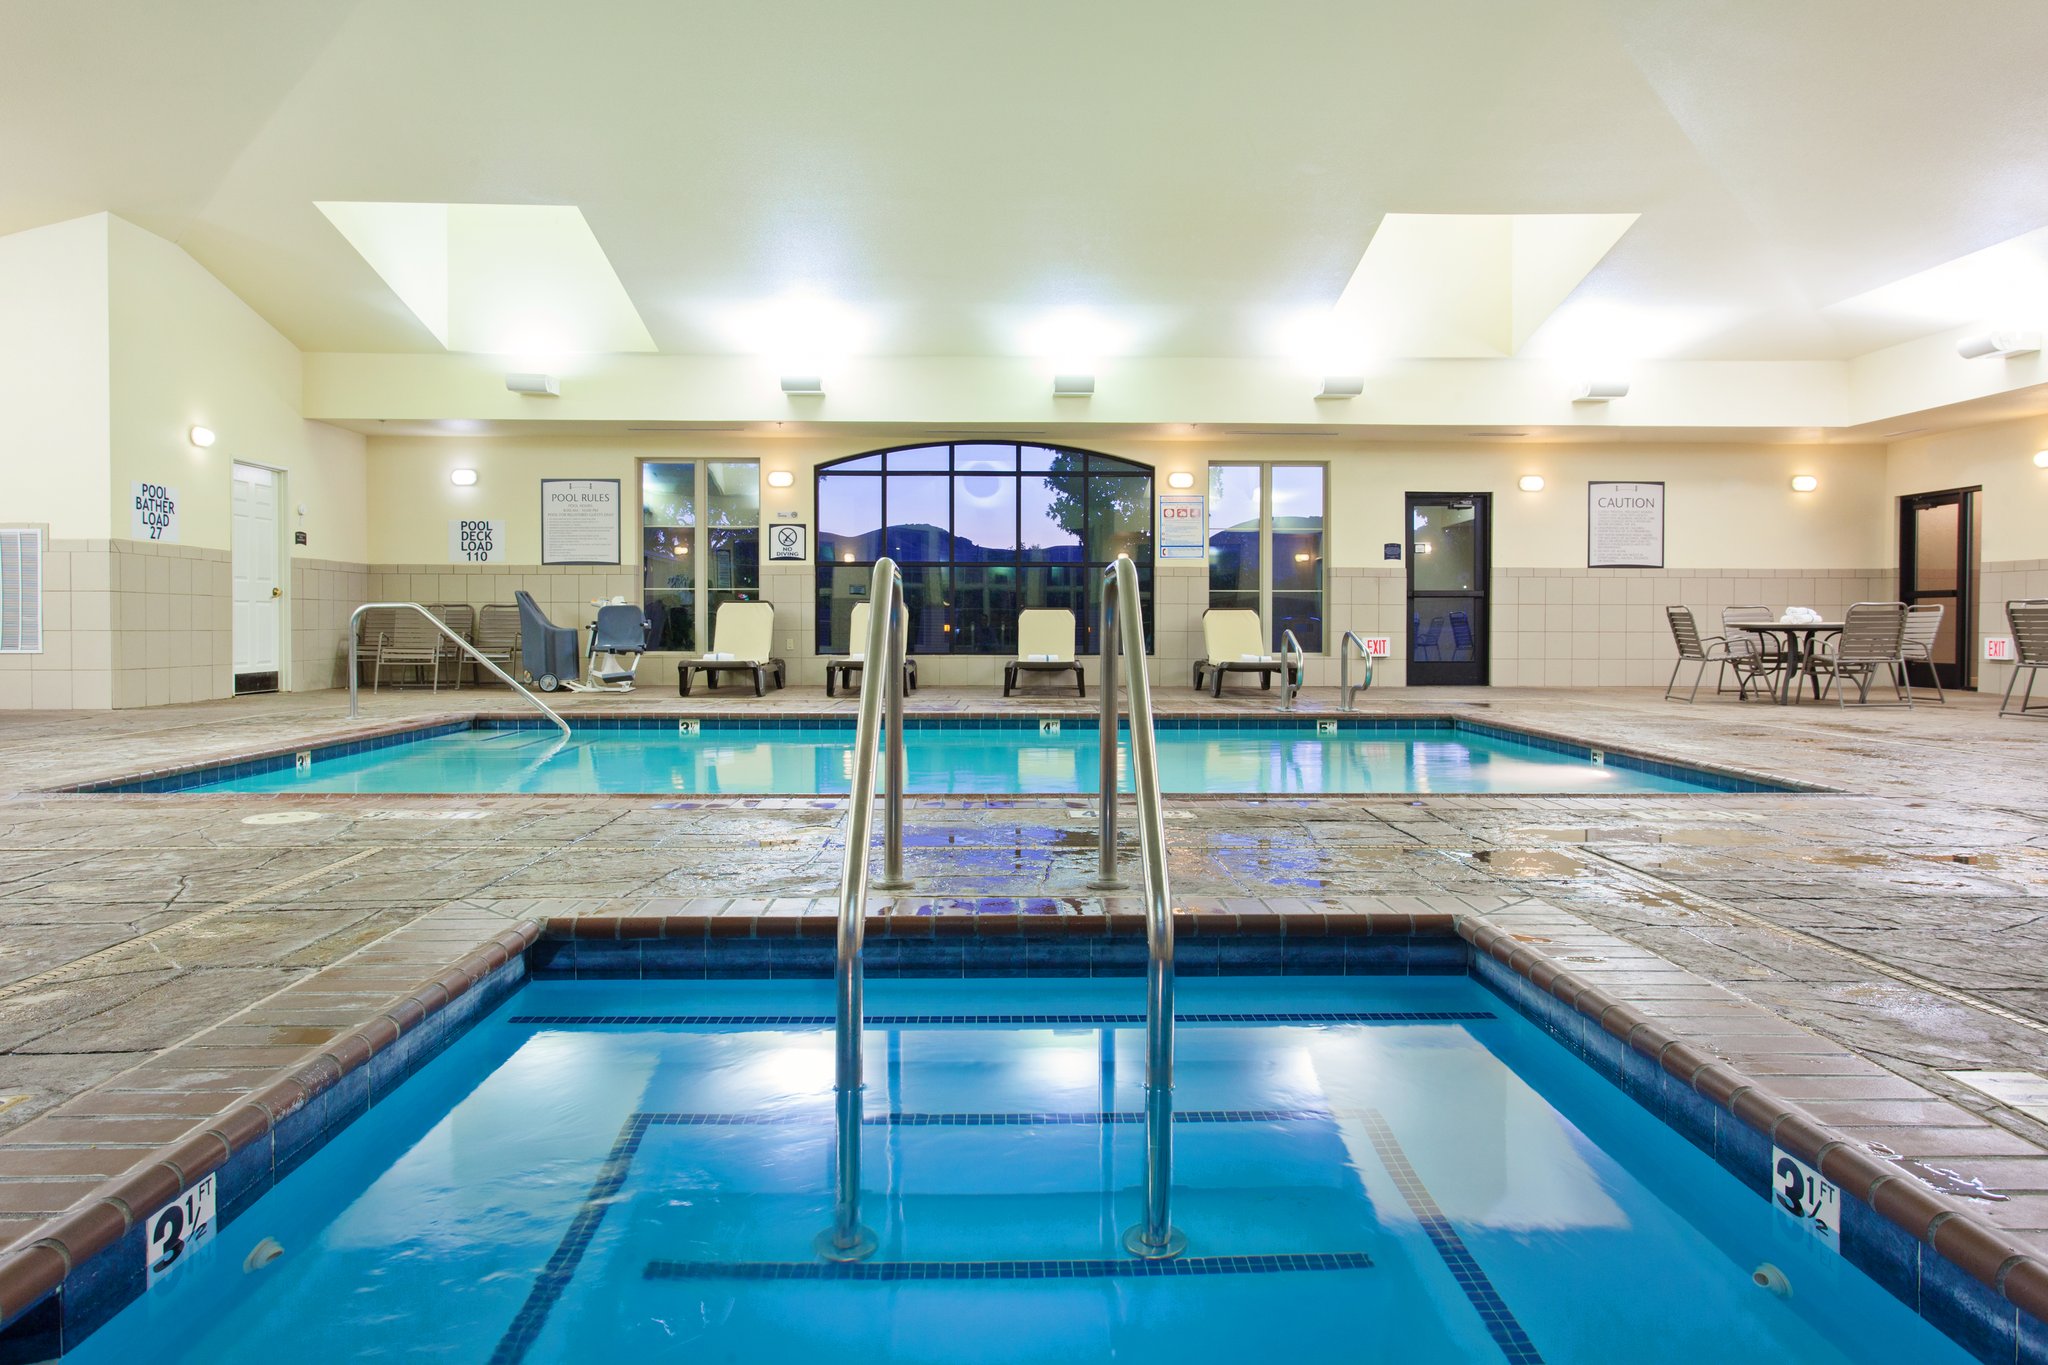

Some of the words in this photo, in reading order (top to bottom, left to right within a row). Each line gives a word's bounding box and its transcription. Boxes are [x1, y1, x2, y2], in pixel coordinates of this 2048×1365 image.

[142, 484, 169, 500] POOL
[551, 493, 578, 502] POOL
[581, 493, 610, 502] RULES
[136, 496, 175, 514] BATHER
[1598, 497, 1655, 508] CAUTION
[142, 511, 169, 527] LOAD
[461, 521, 493, 531] POOL
[150, 526, 162, 539] 27
[461, 531, 492, 541] DECK
[461, 541, 493, 551] LOAD
[466, 552, 488, 562] 110
[1367, 640, 1387, 655] EXIT
[1988, 640, 2005, 656] EXIT
[1776, 1157, 1805, 1218] 3
[1820, 1180, 1836, 1204] FT
[153, 1205, 184, 1273] 3
[198, 1178, 212, 1202] FT
